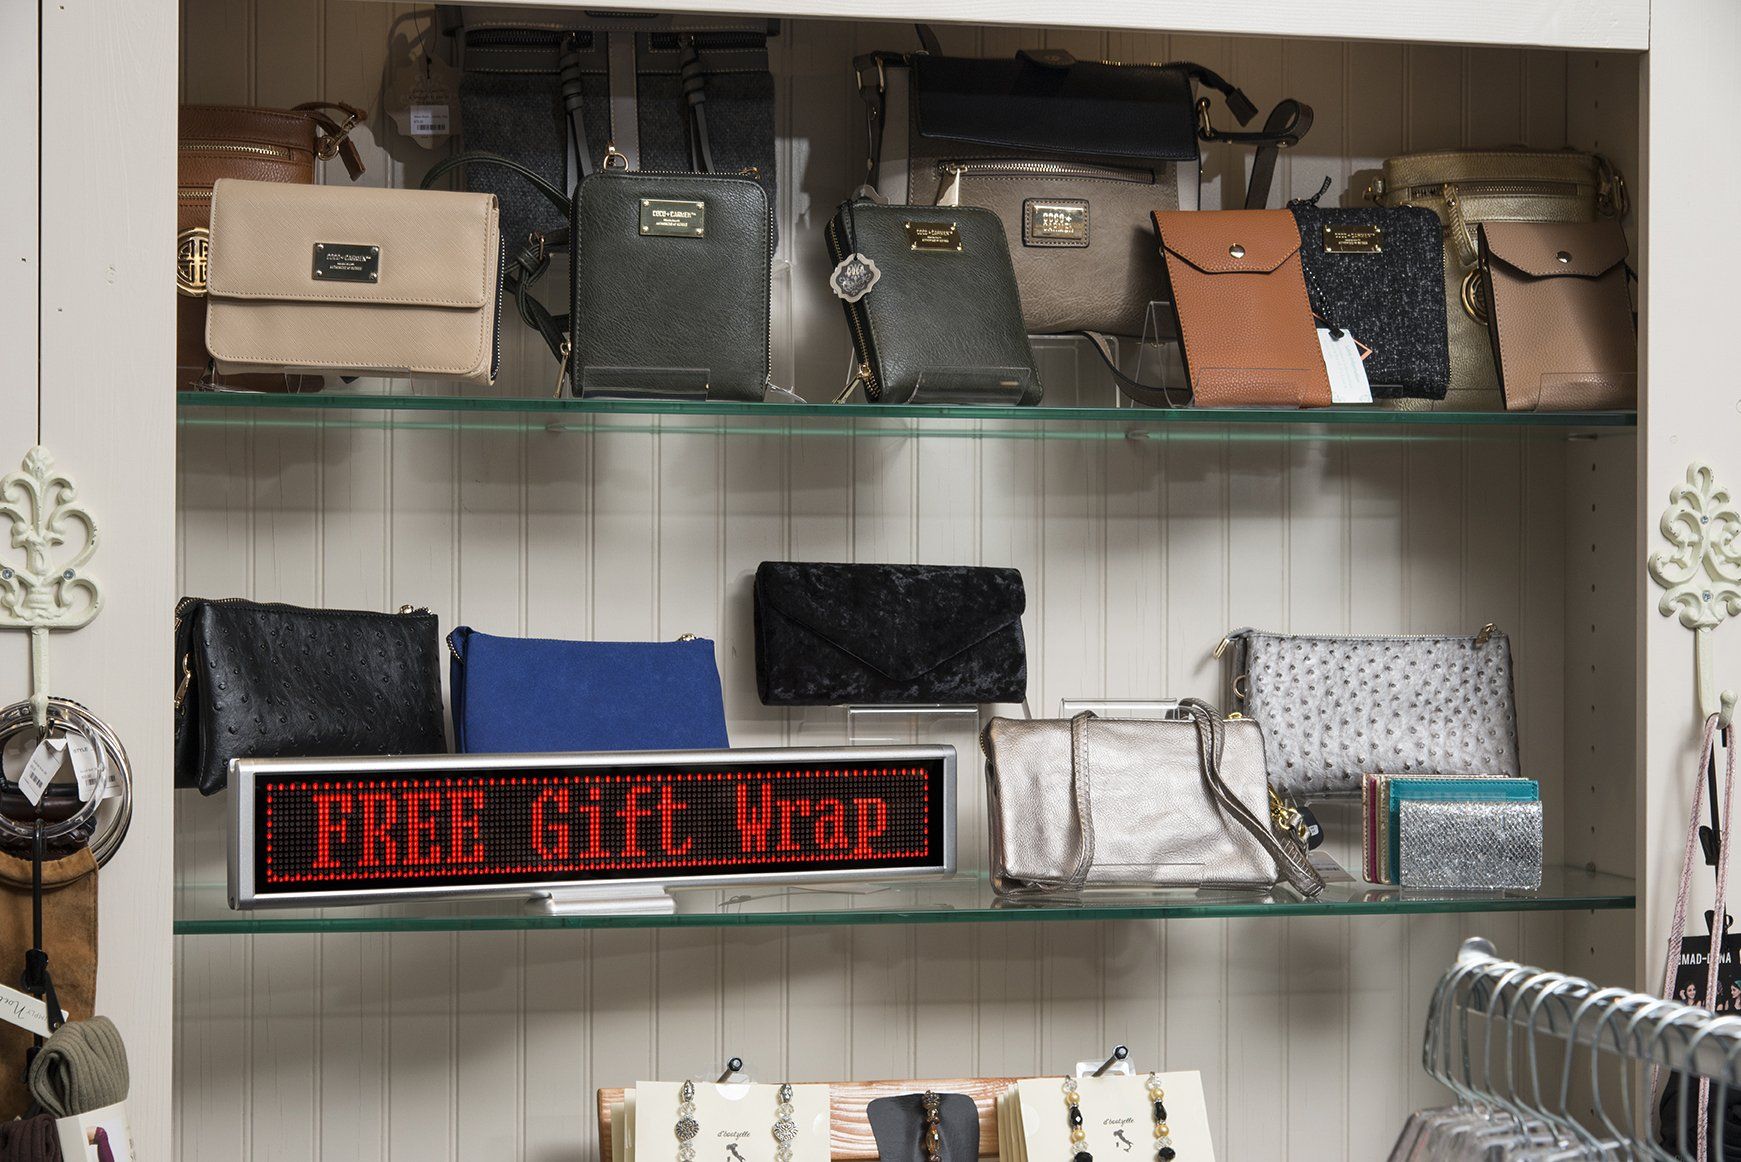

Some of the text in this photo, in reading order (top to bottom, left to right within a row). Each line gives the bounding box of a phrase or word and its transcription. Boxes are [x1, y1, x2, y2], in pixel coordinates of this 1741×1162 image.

[313, 783, 888, 870] FREE Gift Wrap
